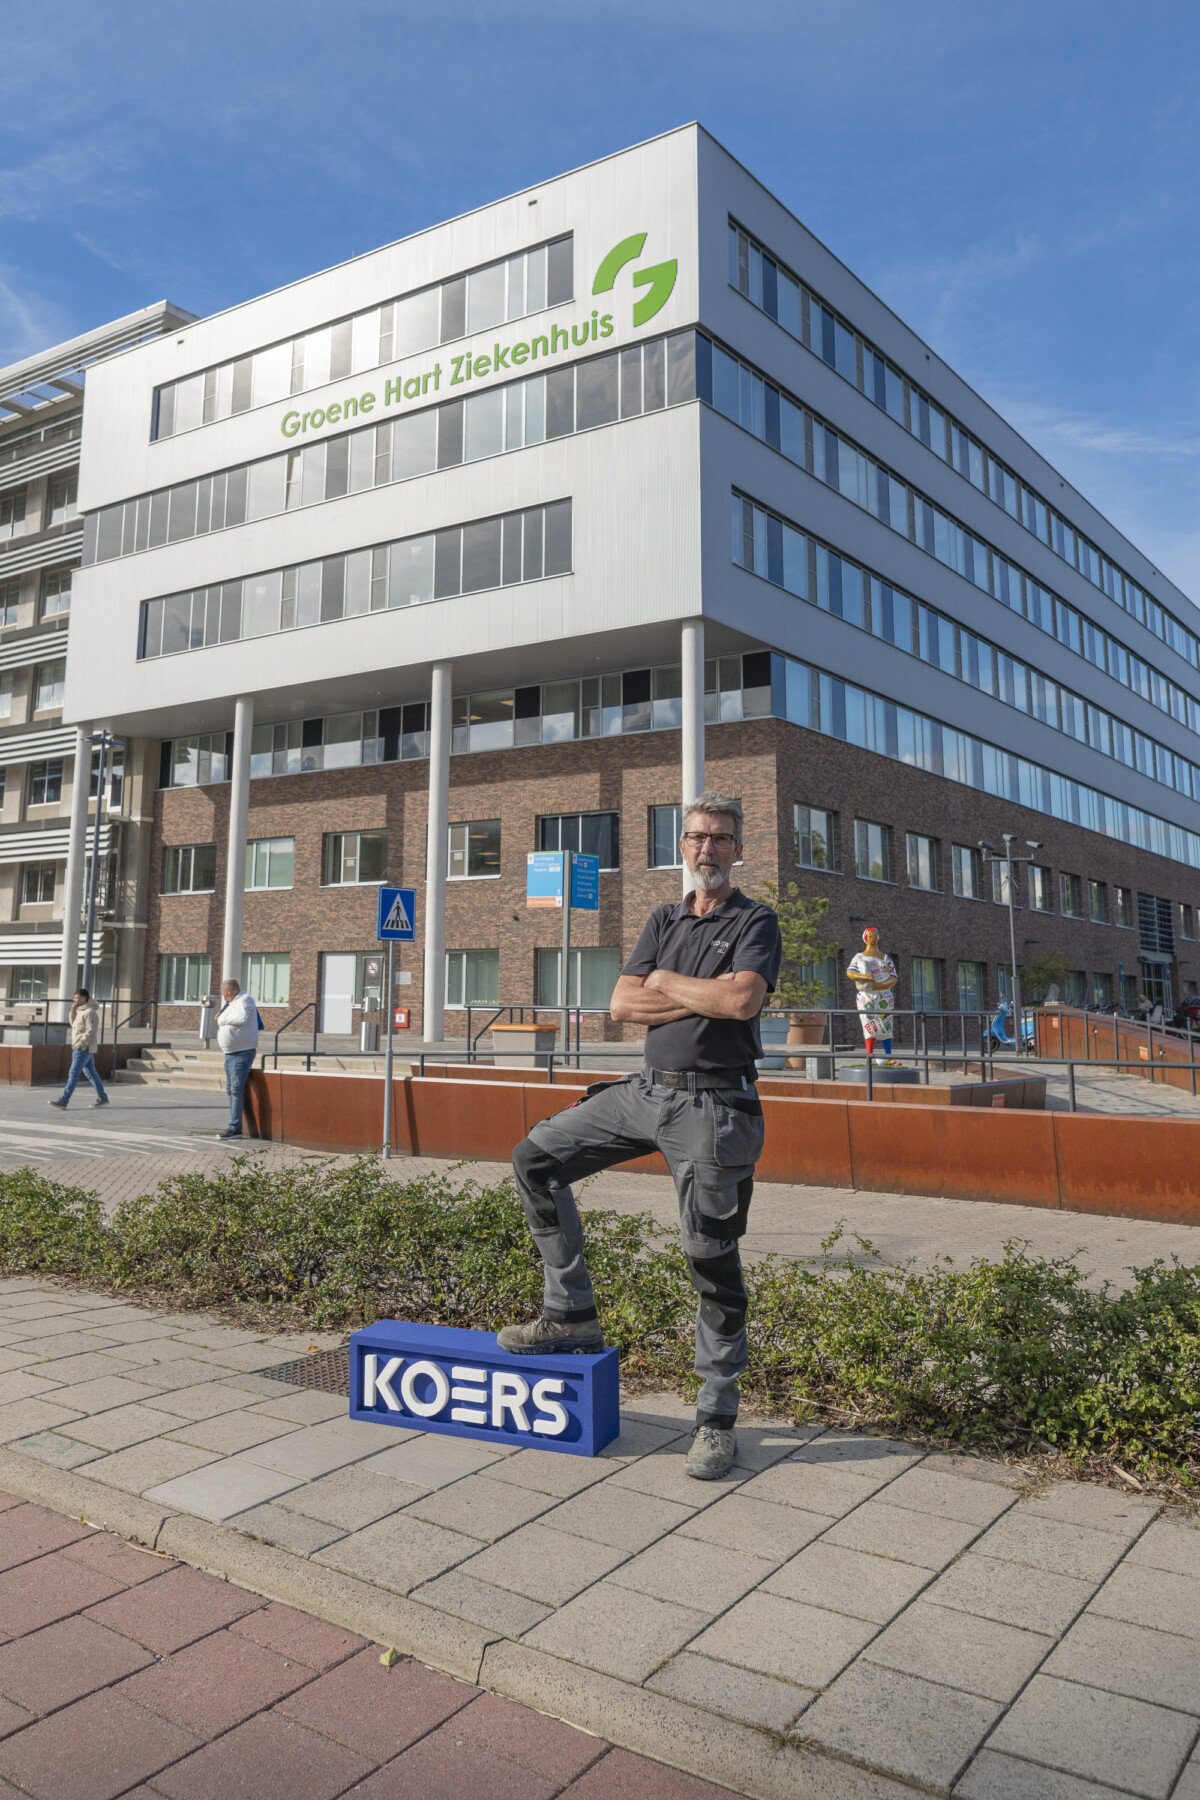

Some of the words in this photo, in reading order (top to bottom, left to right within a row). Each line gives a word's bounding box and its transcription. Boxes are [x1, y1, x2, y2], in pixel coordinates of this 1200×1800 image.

[281, 392, 375, 438] Groene
[385, 365, 442, 406] Hart
[450, 310, 614, 386] Ziekenhuis
[363, 1354, 569, 1436] KOERS
